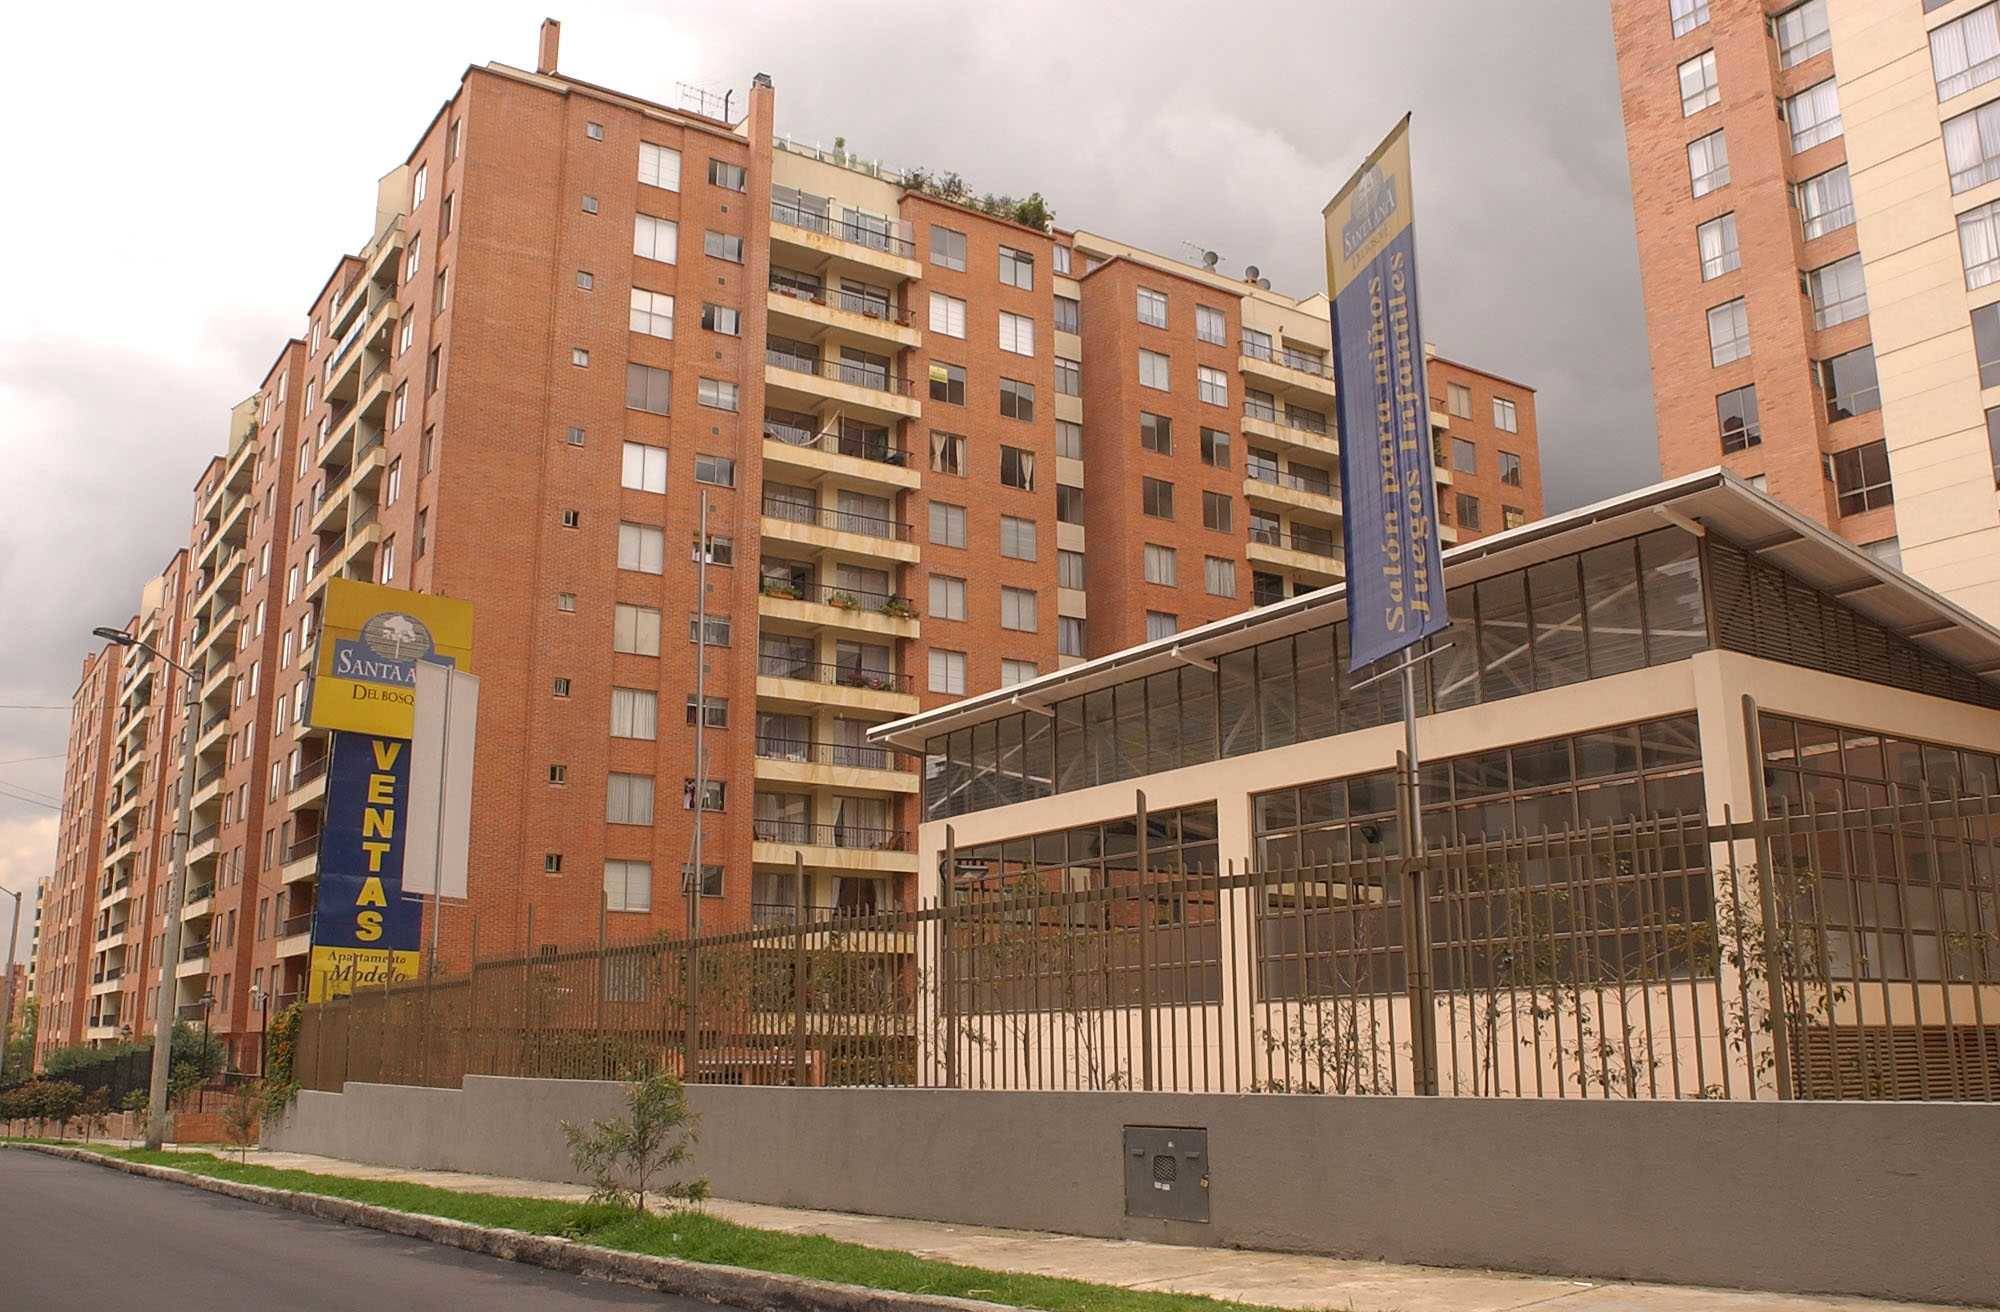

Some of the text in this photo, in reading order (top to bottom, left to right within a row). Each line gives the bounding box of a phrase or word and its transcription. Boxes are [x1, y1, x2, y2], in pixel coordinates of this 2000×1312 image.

[1368, 275, 1388, 384] niños
[1377, 400, 1399, 493] para
[1388, 251, 1430, 624] Juegos Infantiles
[1381, 509, 1405, 632] Salón
[337, 649, 402, 682] SANTA
[382, 690, 416, 705] BOSQ
[356, 740, 401, 942] VENTAS
